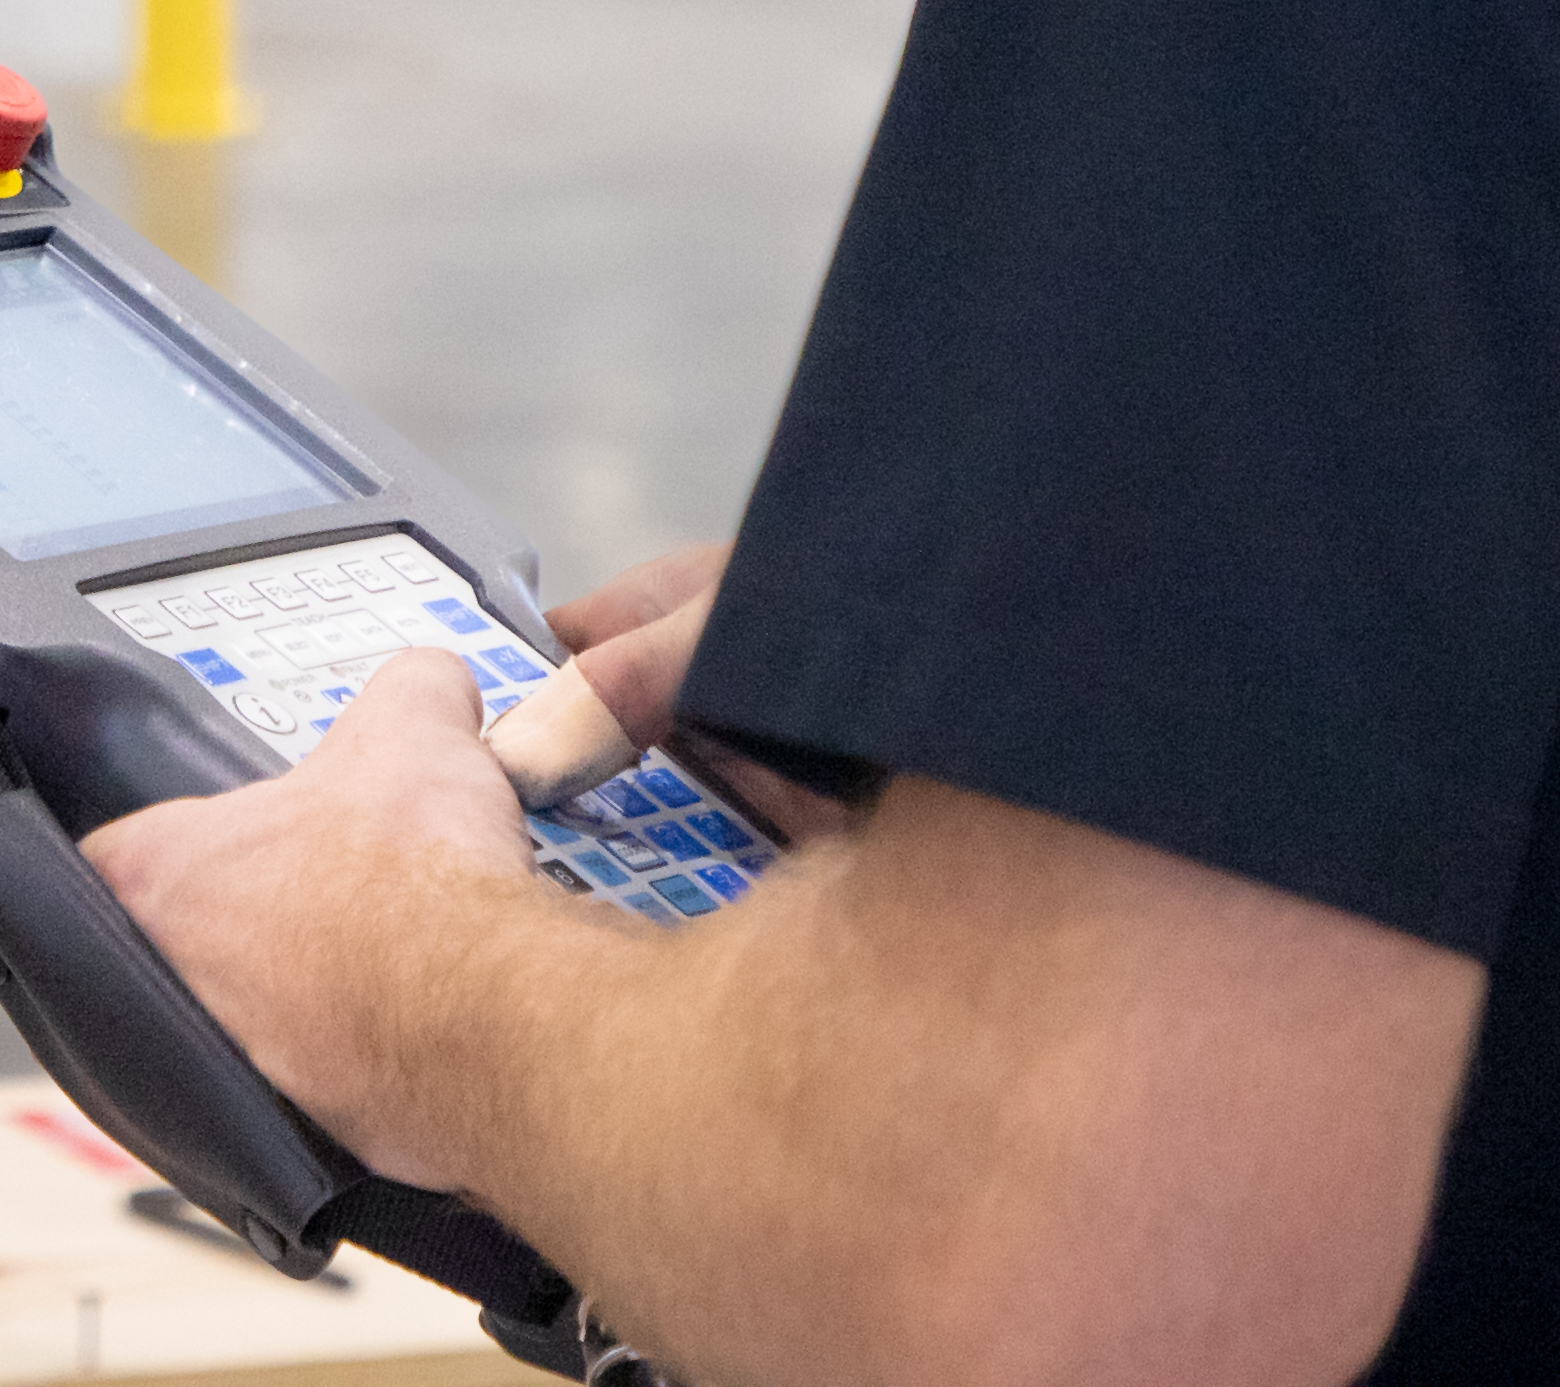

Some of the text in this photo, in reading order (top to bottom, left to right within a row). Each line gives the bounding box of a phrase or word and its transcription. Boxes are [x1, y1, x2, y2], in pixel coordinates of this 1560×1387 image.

[354, 568, 382, 583] F5
[310, 577, 337, 591] F4
[266, 585, 293, 600] F3
[221, 595, 248, 609] F2
[175, 604, 202, 619] F1
[291, 612, 331, 626] TEACH
[340, 661, 371, 674] FAULT
[280, 673, 318, 687] POWER
